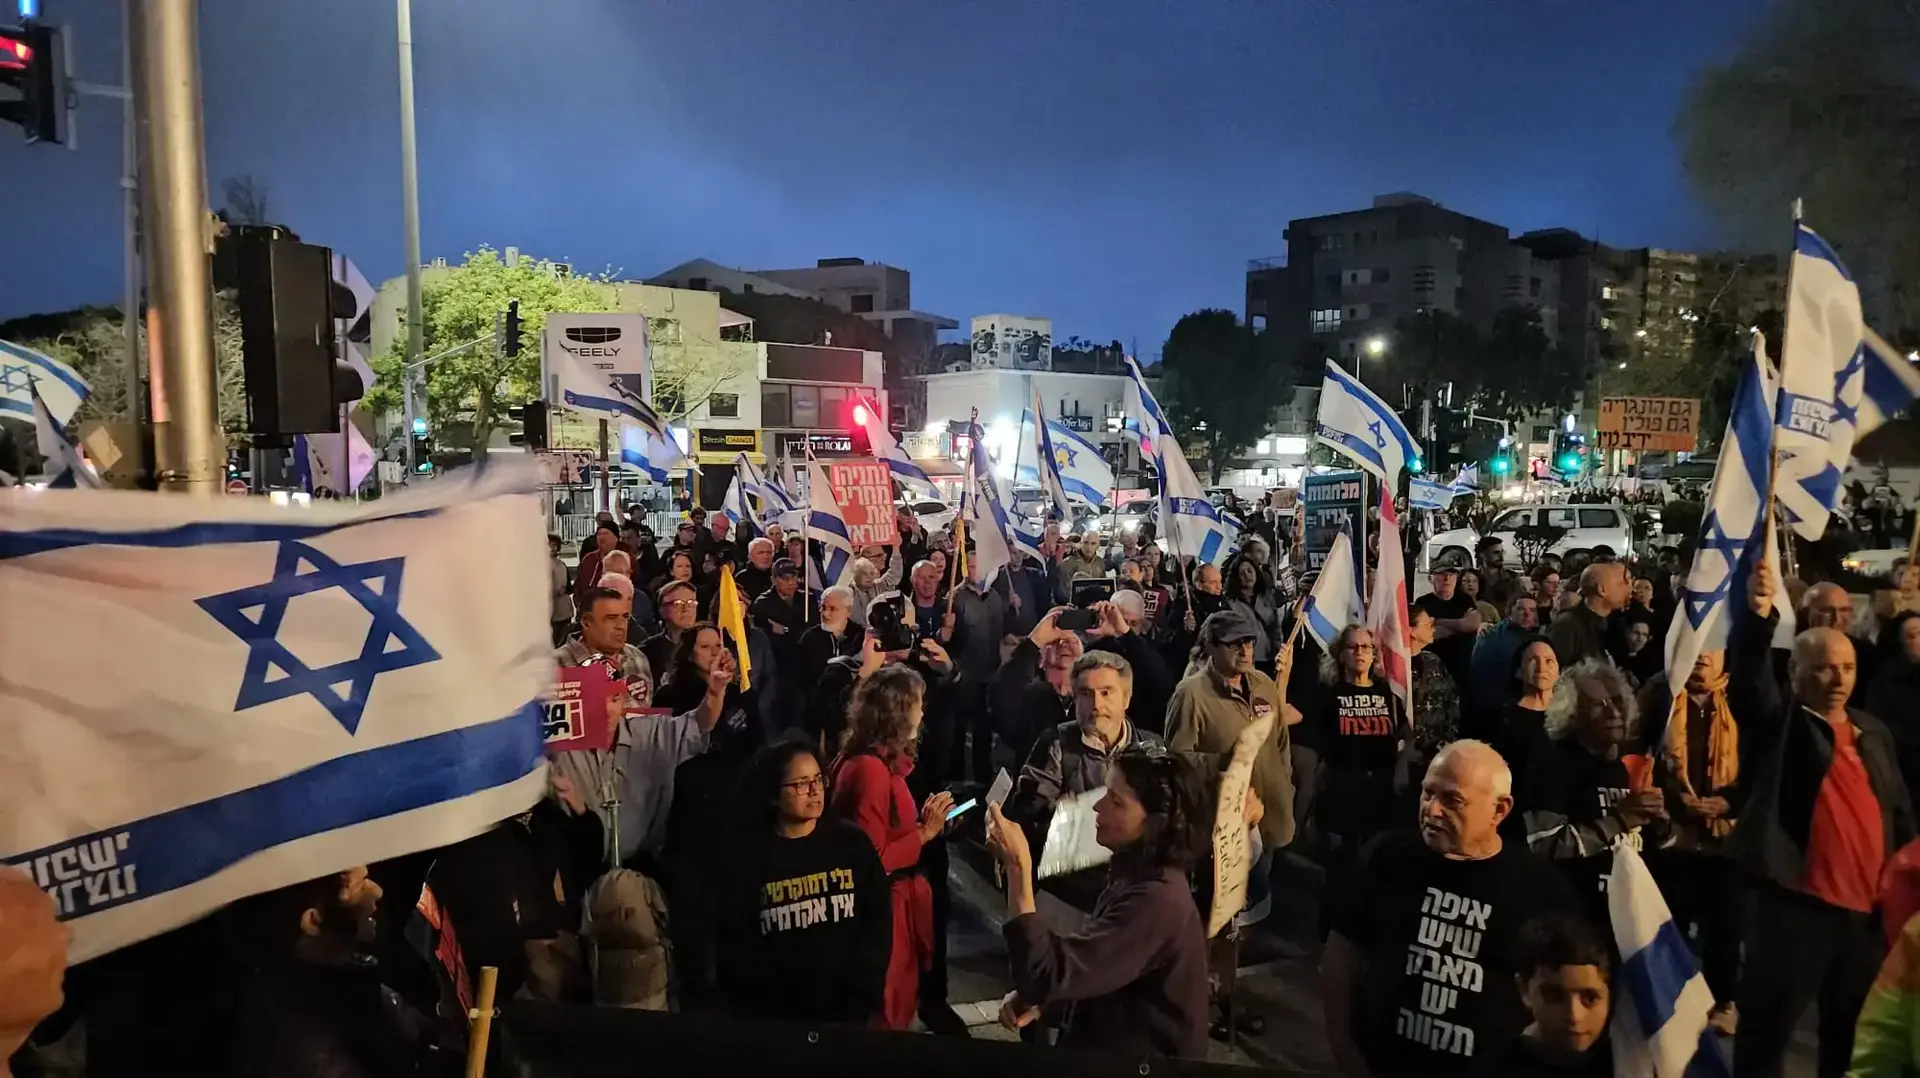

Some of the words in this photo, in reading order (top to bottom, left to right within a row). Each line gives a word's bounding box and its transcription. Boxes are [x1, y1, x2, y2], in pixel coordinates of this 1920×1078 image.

[1603, 399, 1666, 415] הונגריה
[1669, 401, 1692, 416] גם
[1622, 416, 1663, 432] פולין
[1667, 418, 1690, 433] גם
[703, 436, 726, 444] Bitcoin
[727, 436, 754, 444] CHANGE
[787, 437, 816, 453] רלדין
[833, 465, 889, 486] נתניהו
[835, 485, 891, 506] מחריב
[1307, 481, 1360, 501] מלחמות
[866, 505, 893, 524] את
[852, 523, 895, 543] ישרא
[1337, 696, 1353, 708] עד
[1354, 695, 1371, 708] פה
[1597, 787, 1630, 807] יפה
[830, 868, 855, 890] בלי
[760, 897, 828, 935] אקדמיה
[831, 893, 855, 922] אין
[1421, 886, 1493, 930] איפה
[1418, 916, 1482, 959] שיש
[1405, 943, 1484, 992] מאבק
[1420, 981, 1458, 1015] יש
[1397, 1007, 1475, 1057] תקווה
